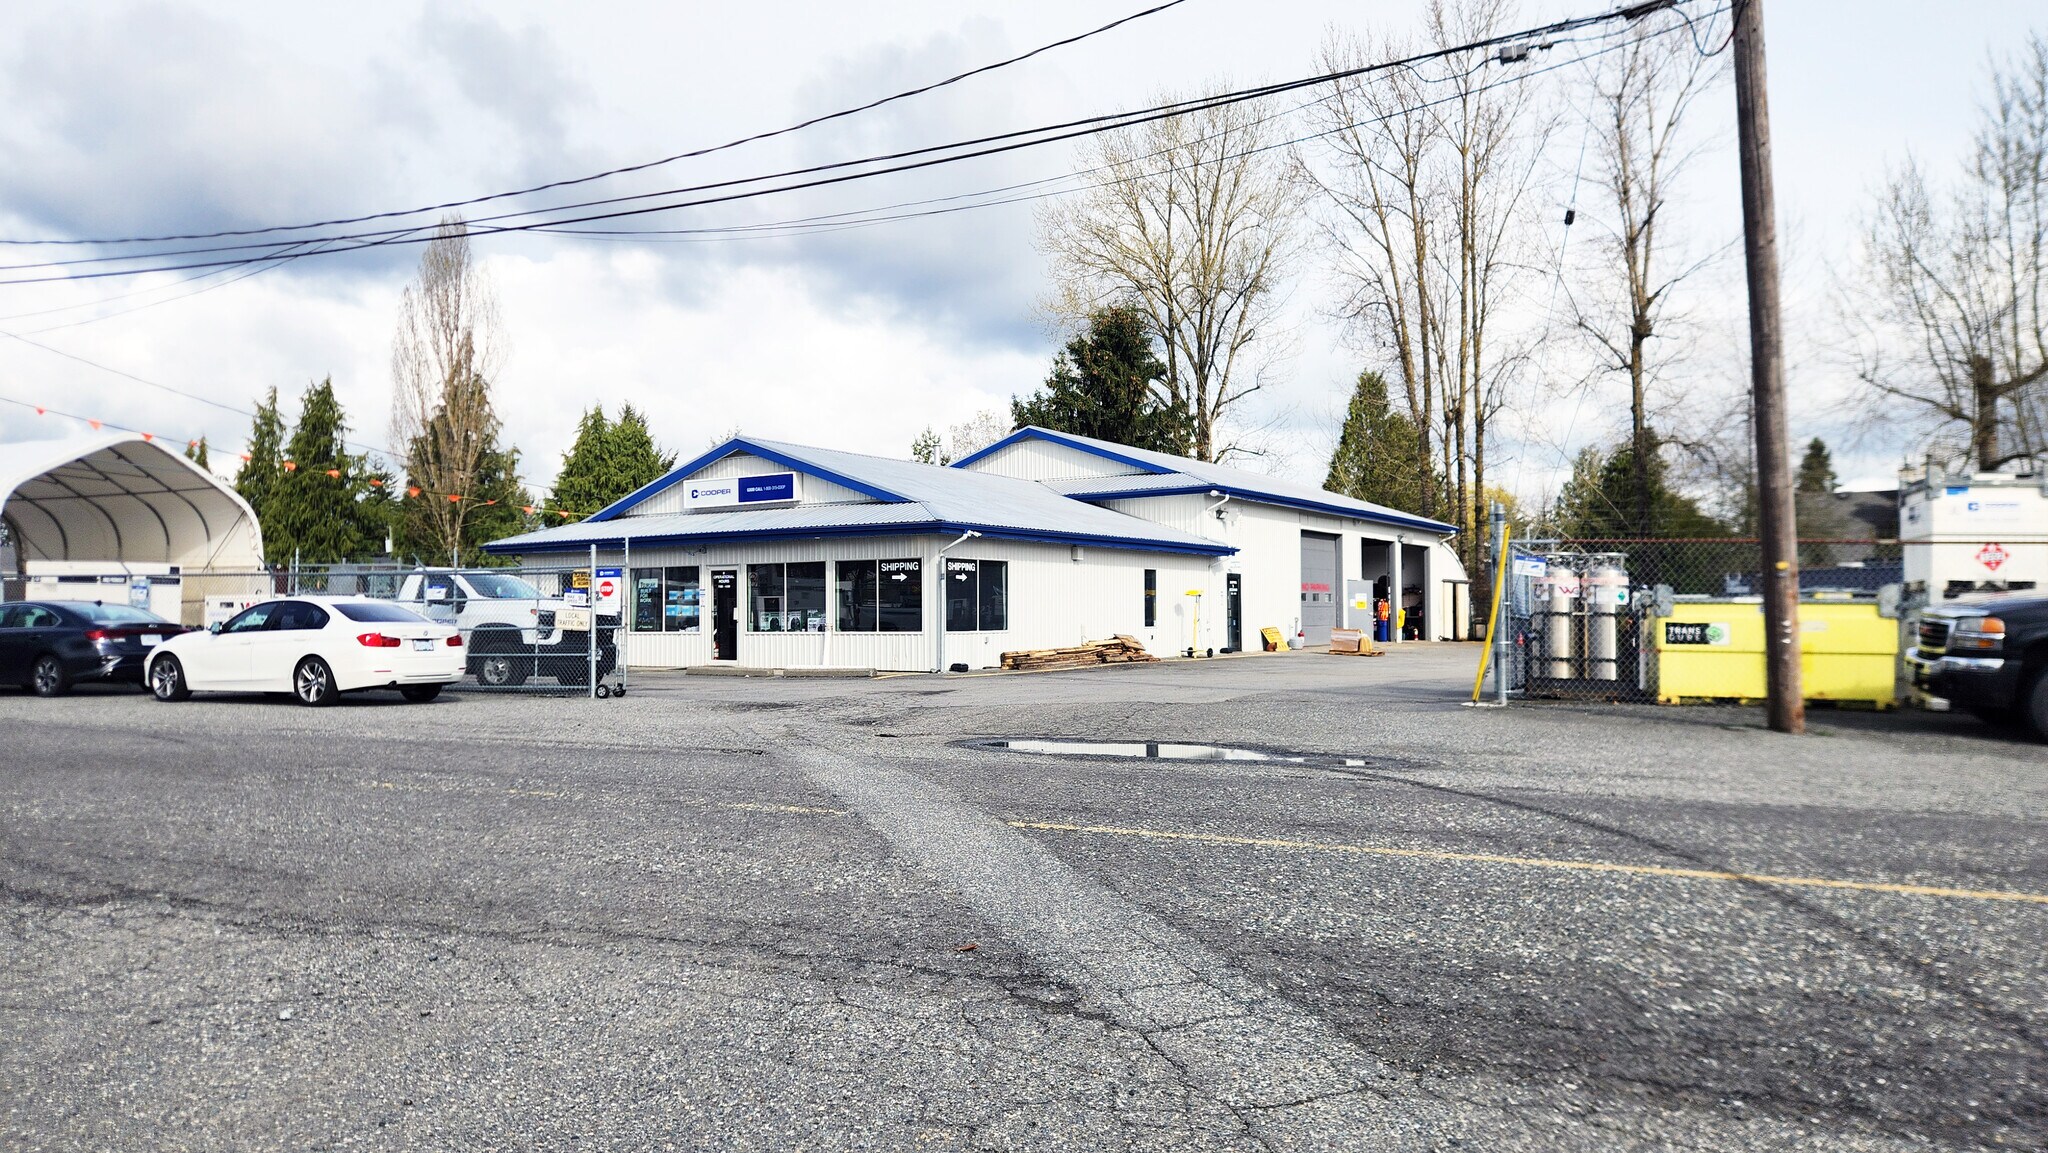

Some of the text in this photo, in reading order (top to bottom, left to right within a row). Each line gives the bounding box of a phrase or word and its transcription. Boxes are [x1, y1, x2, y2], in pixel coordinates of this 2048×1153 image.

[881, 561, 919, 571] SHIPPING
[947, 561, 976, 571] SHIPPING
[601, 585, 614, 593] STOP
[1302, 583, 1329, 592] NO PARKING
[576, 620, 588, 628] ONLY
[1669, 626, 1701, 635] TRANS
